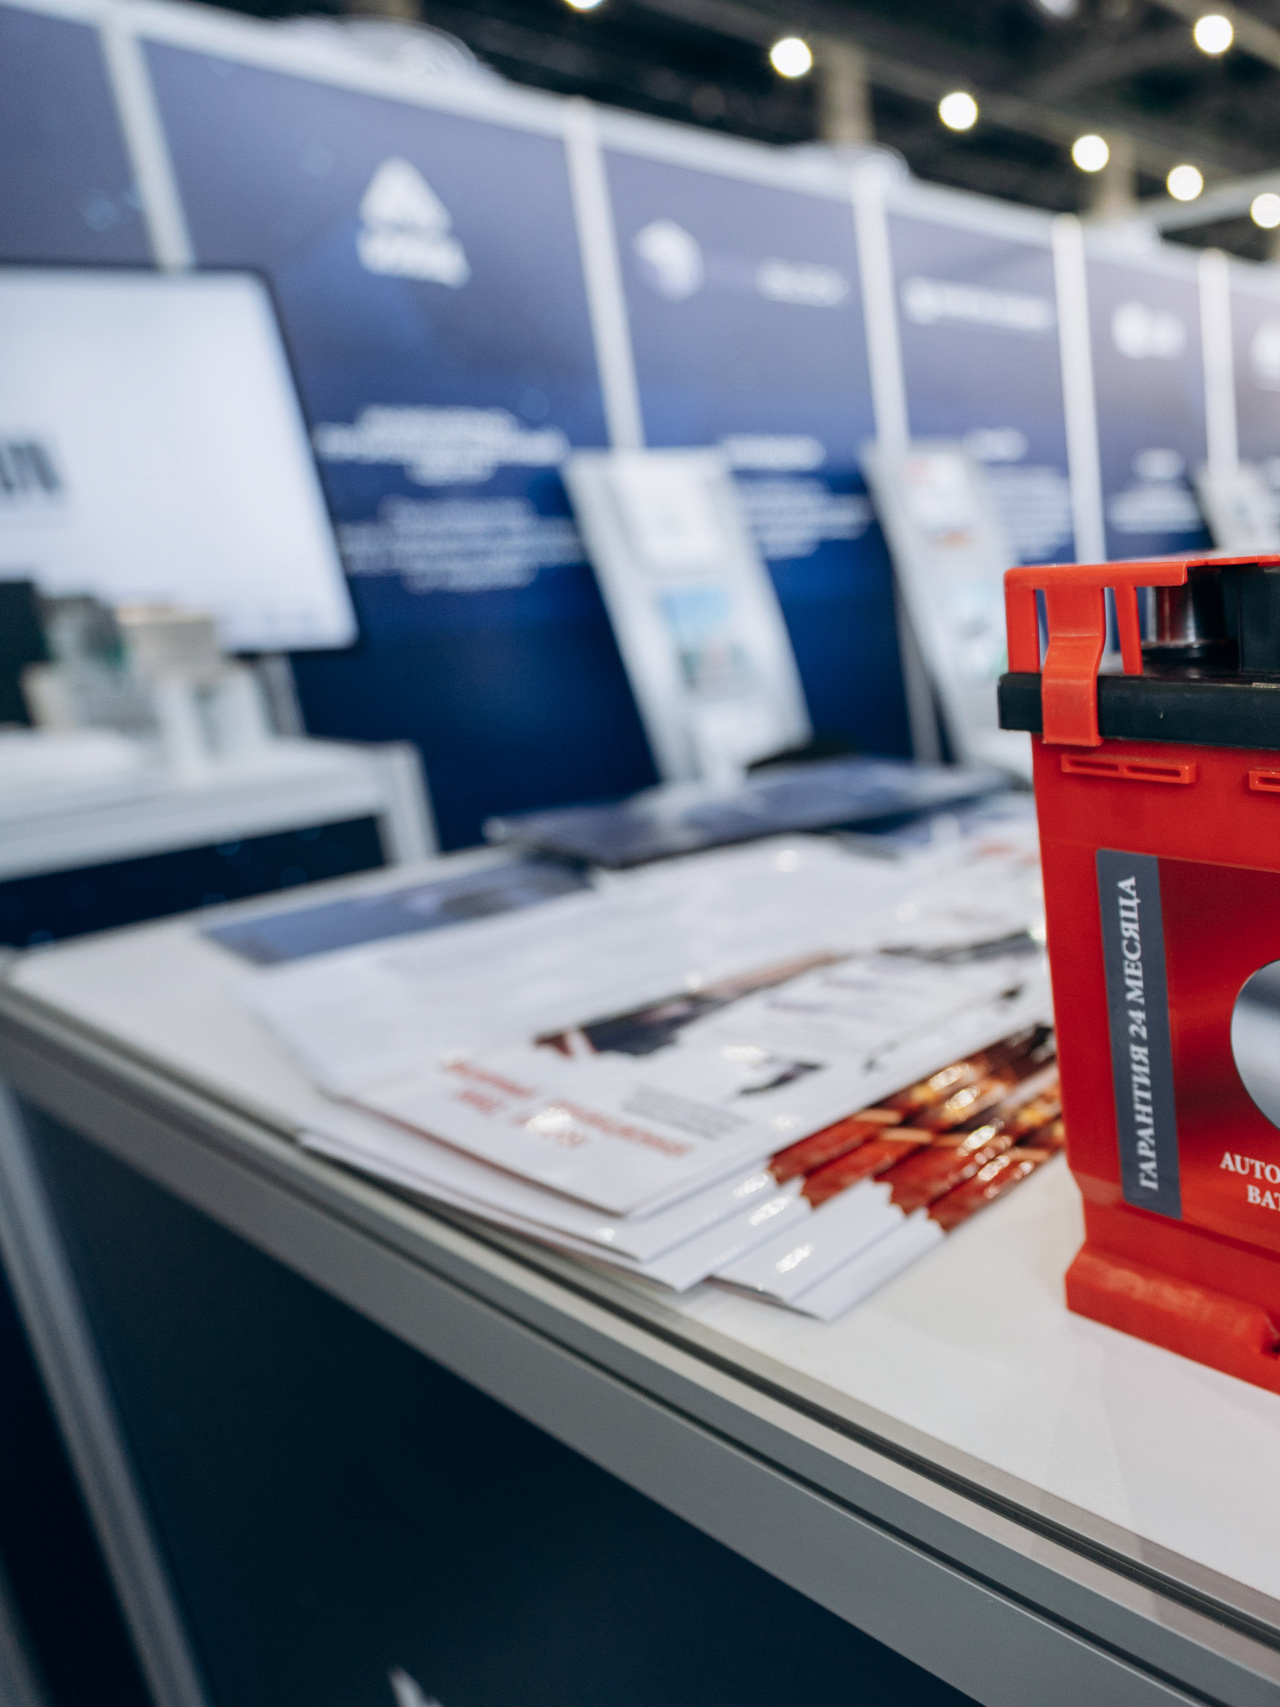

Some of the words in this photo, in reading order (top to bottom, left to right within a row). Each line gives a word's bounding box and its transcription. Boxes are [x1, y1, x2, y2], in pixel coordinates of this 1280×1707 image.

[1117, 875, 1146, 1005] МЕСЯЦА
[1128, 1009, 1148, 1040] 24
[1129, 1043, 1159, 1191] ГАРАНТИЯ
